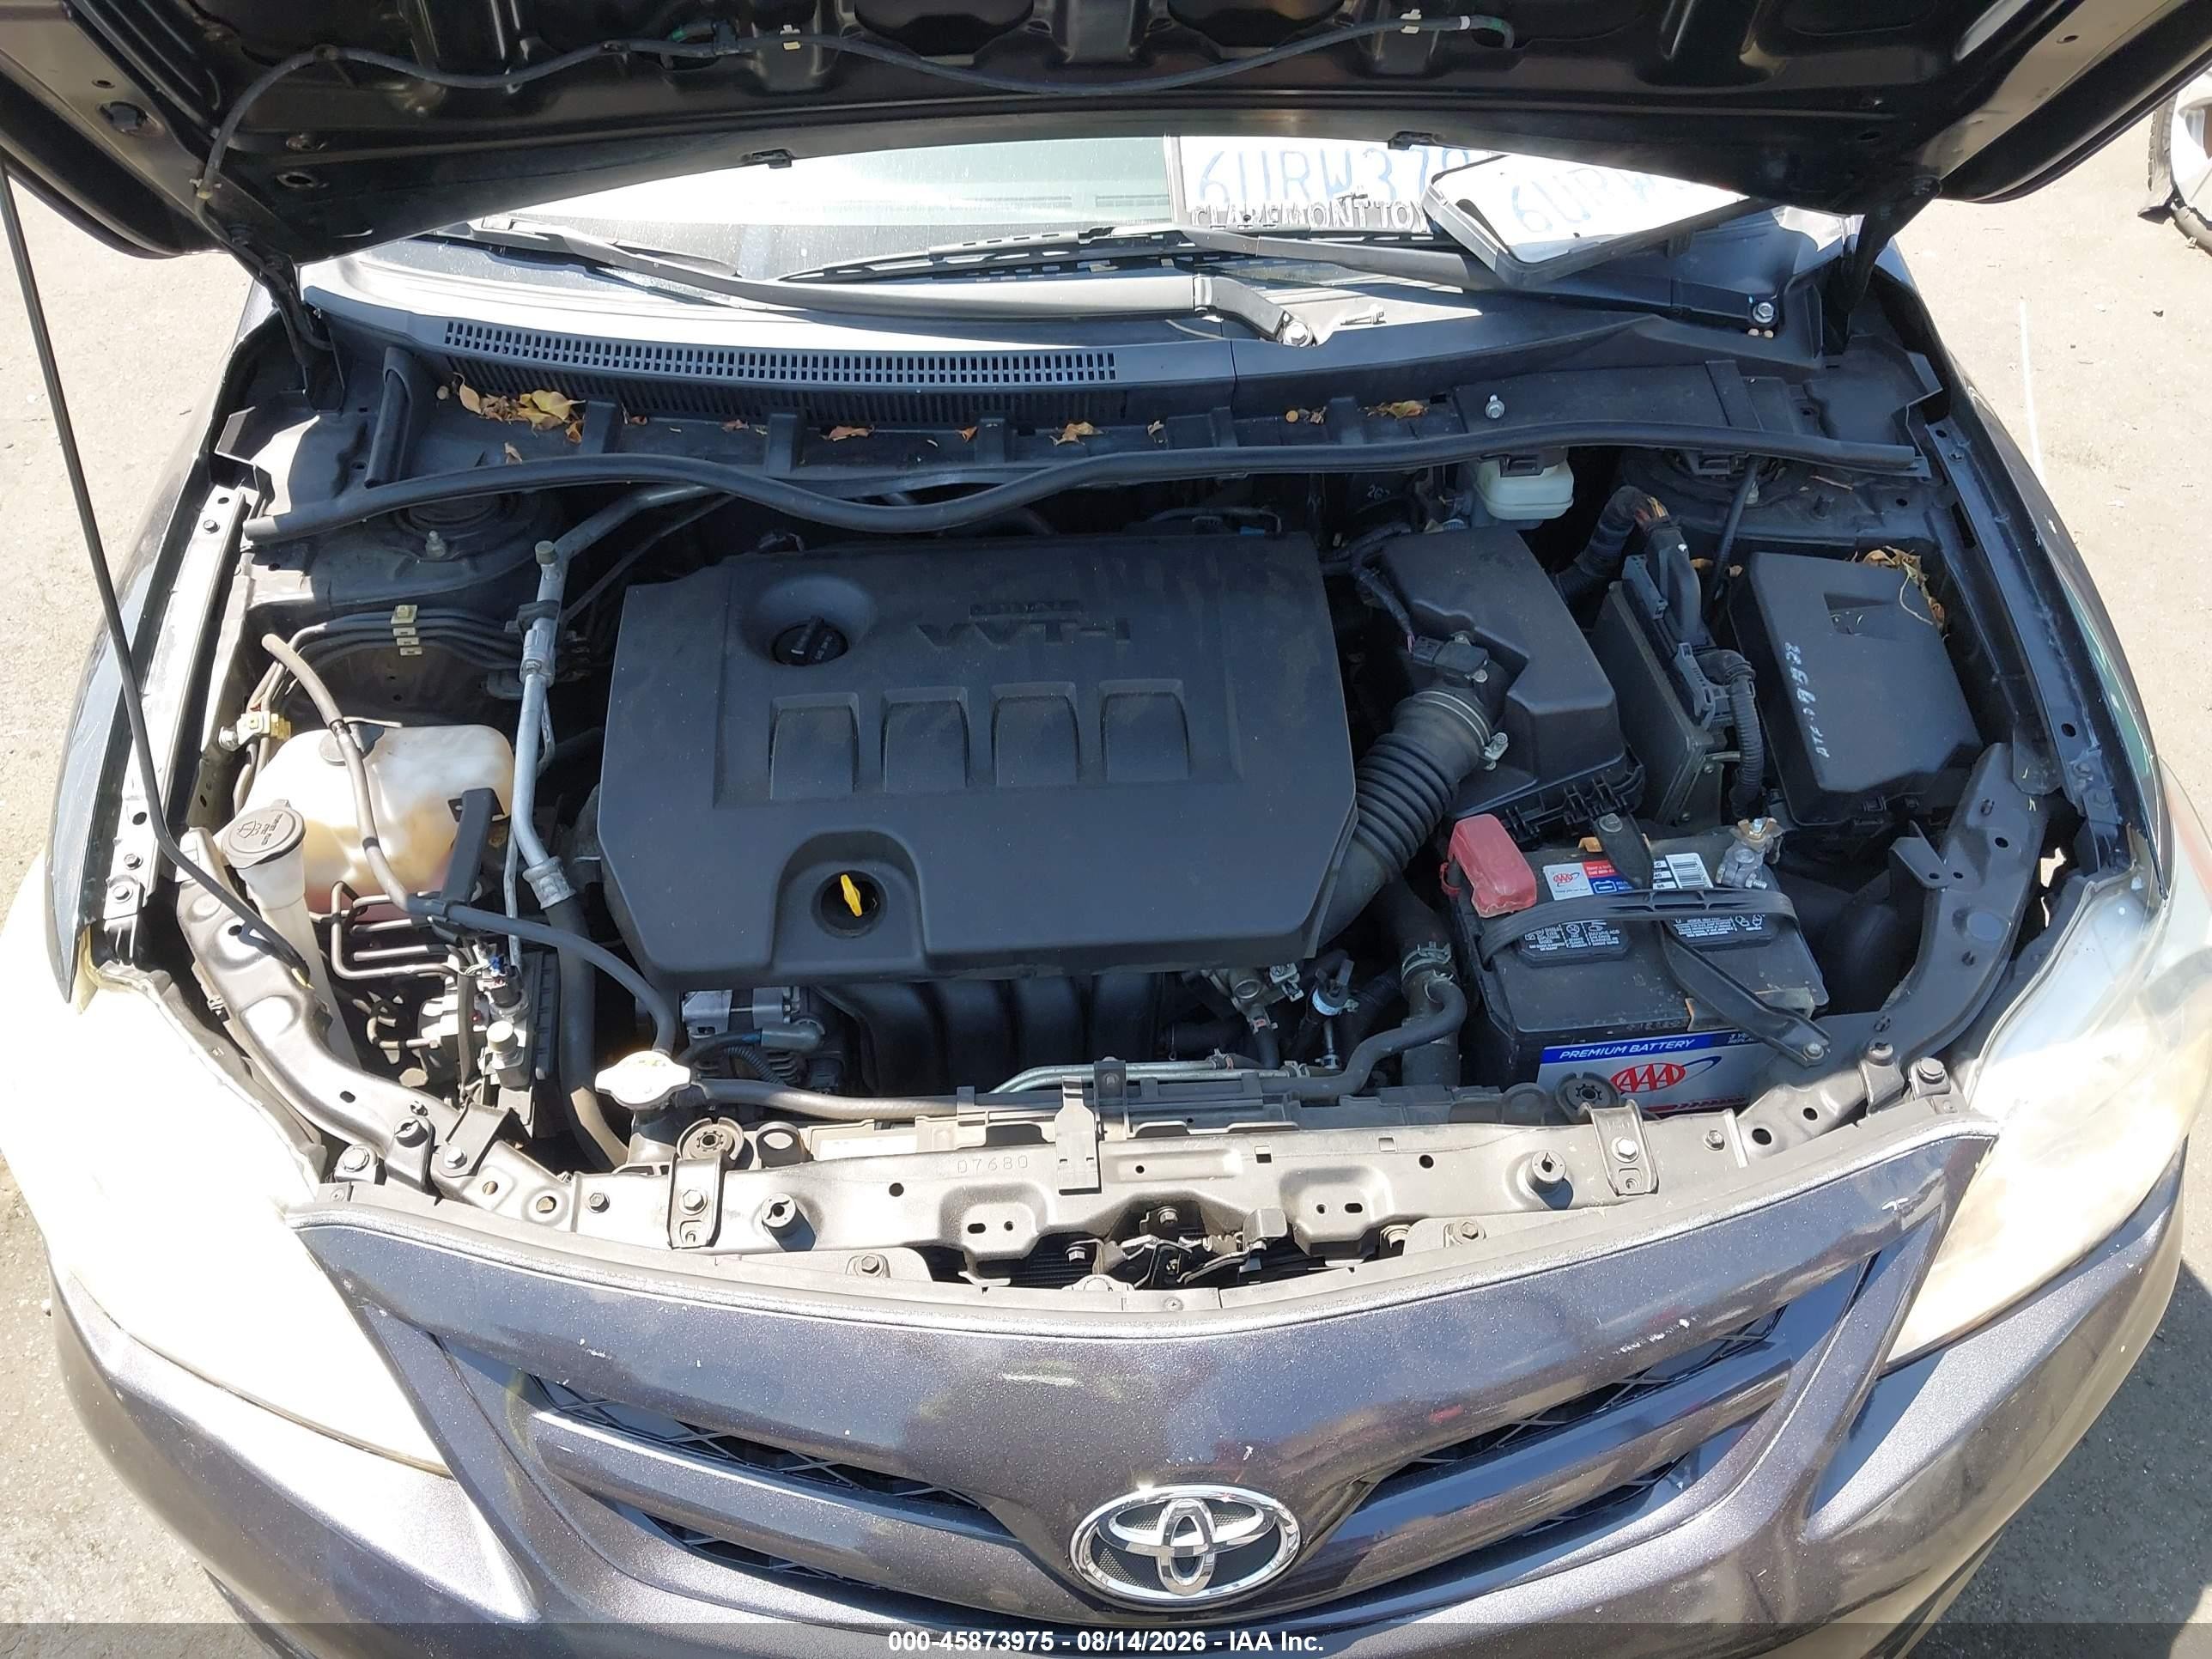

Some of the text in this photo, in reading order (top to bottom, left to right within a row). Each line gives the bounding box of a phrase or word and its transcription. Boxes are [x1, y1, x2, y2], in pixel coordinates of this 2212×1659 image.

[1559, 1038, 1698, 1060] PREMIUM BATTERY
[1611, 1064, 1686, 1093] AAA
